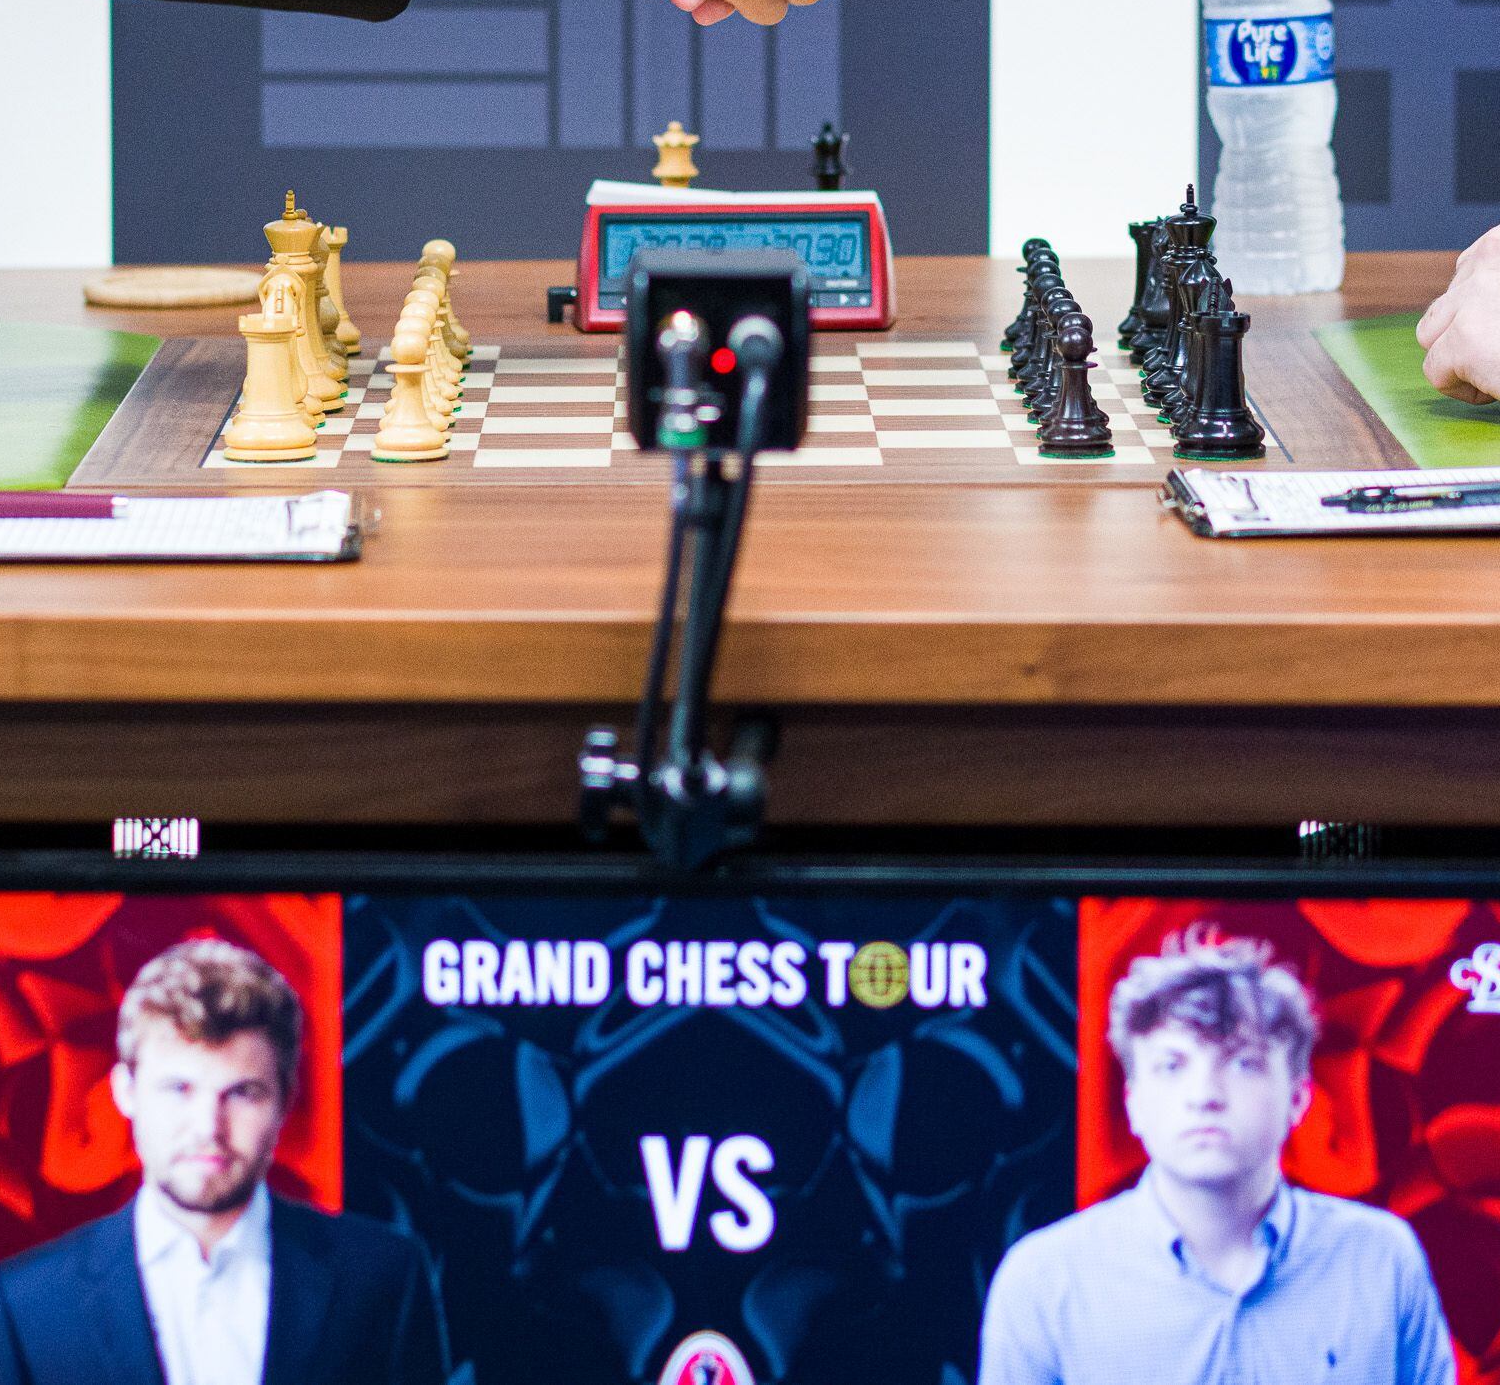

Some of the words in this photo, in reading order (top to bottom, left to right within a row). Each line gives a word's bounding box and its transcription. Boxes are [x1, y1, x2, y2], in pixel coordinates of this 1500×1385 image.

[1238, 21, 1288, 44] Pure
[1244, 42, 1284, 68] Life
[422, 938, 611, 1007] GRAND
[625, 939, 808, 1007] CHESS
[818, 940, 989, 1009] TOUR
[639, 1134, 776, 1253] VS
